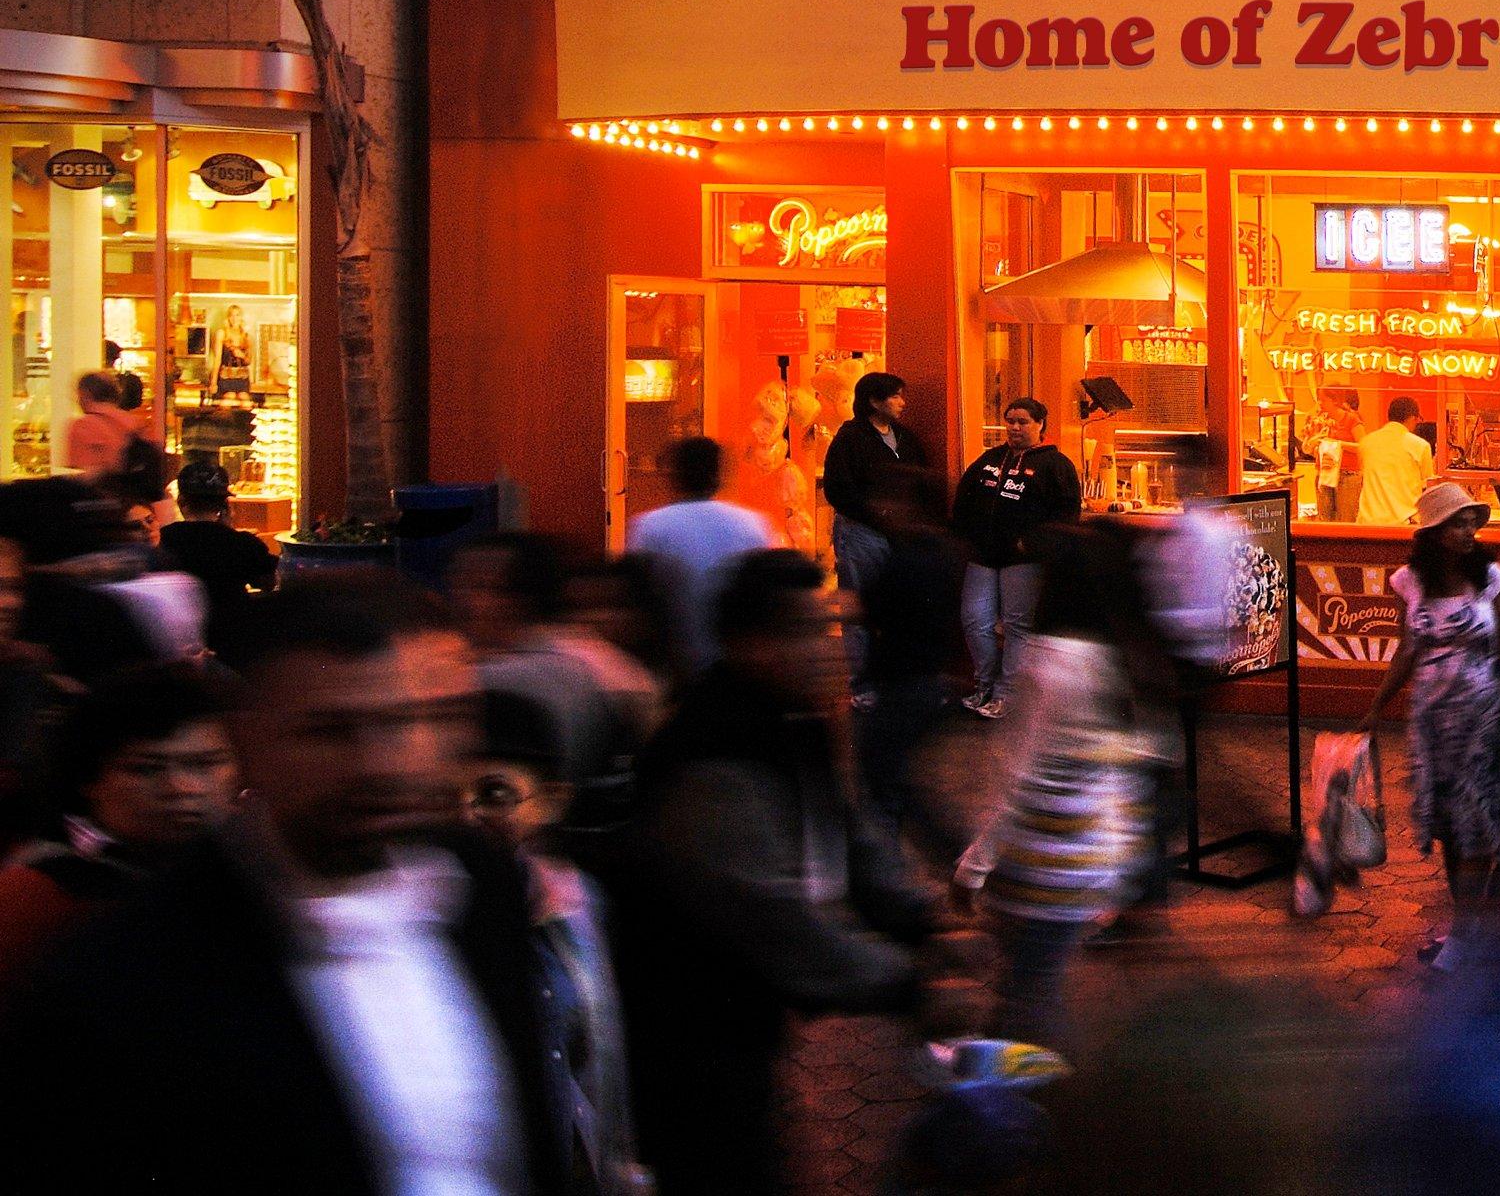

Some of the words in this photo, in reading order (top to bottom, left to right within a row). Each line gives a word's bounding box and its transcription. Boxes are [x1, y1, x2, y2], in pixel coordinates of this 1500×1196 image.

[900, 4, 1156, 69] Home
[1180, 0, 1273, 67] of
[52, 163, 112, 177] FOSSIL
[1323, 207, 1447, 265] ICEE
[1298, 309, 1377, 333] FRESH
[1387, 312, 1464, 337] FROM
[1267, 349, 1315, 371] THE
[1322, 350, 1415, 374] KETTLE
[1421, 354, 1499, 377] NOW!
